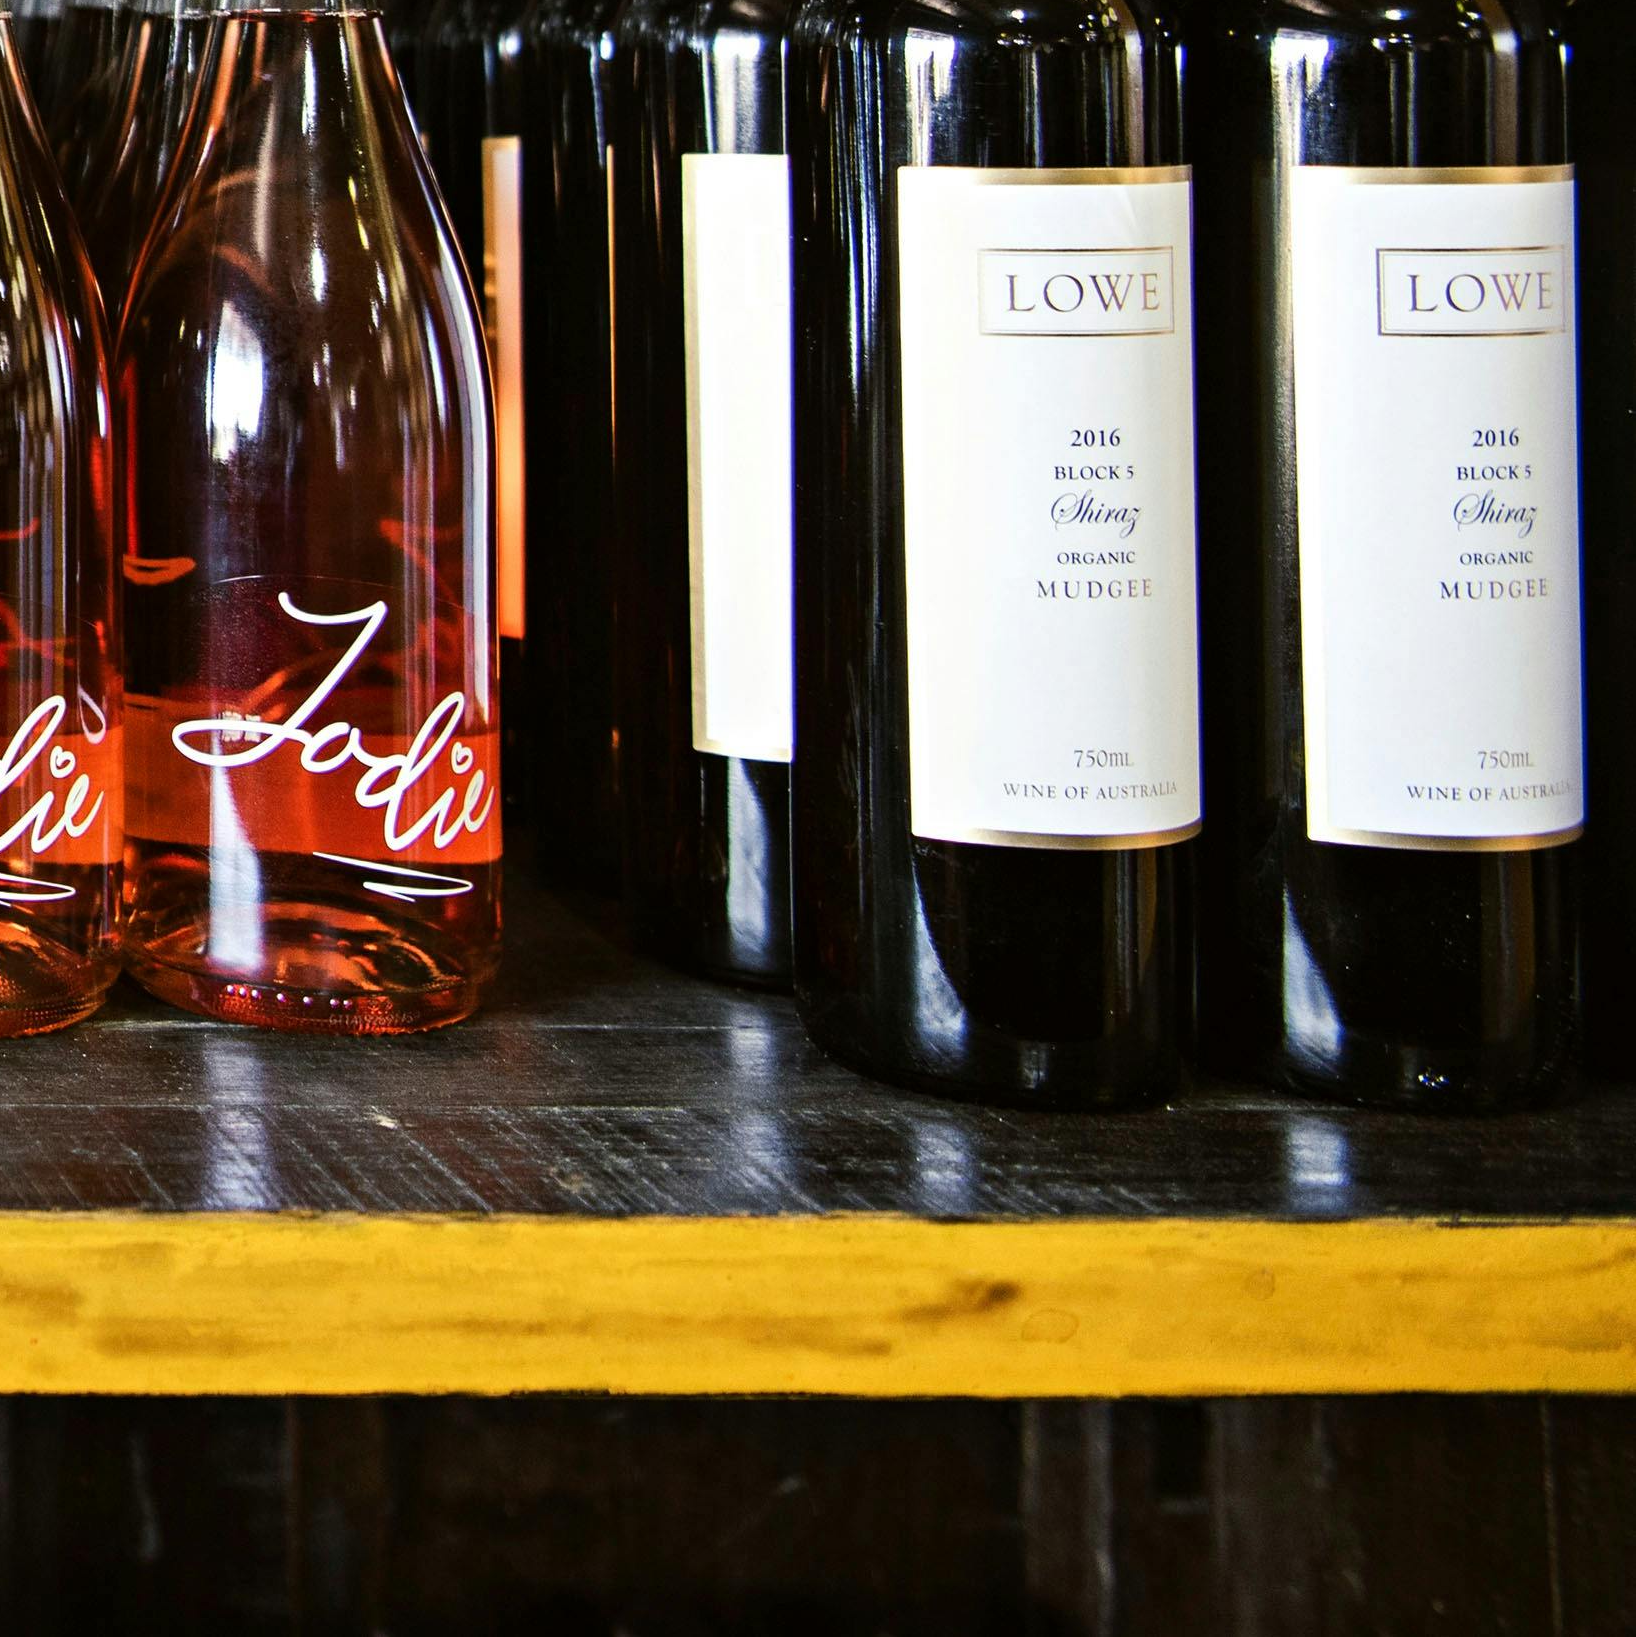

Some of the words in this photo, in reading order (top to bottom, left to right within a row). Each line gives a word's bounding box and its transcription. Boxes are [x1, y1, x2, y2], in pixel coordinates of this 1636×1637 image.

[1006, 273, 1161, 312] LOWE
[1407, 272, 1554, 312] LOWE
[1070, 428, 1121, 447] 2016
[1472, 428, 1520, 447] 2016
[1054, 465, 1121, 480] BLOCK
[1126, 465, 1135, 479] 5
[1457, 465, 1519, 480] BLOCK
[1524, 465, 1532, 479] 5
[1051, 489, 1141, 538] Shiraz
[1453, 489, 1537, 538] Shiraz
[1057, 551, 1136, 565] ORGANIC
[1459, 550, 1534, 565] ORGANIC
[1036, 578, 1152, 599] MUDGEE
[1440, 578, 1548, 599] MUDGEE
[1003, 782, 1056, 799] WINE
[1064, 786, 1089, 799] OF
[1096, 781, 1177, 799] AUSTRALIA
[1406, 785, 1461, 801] WINE
[1468, 787, 1492, 801] OF
